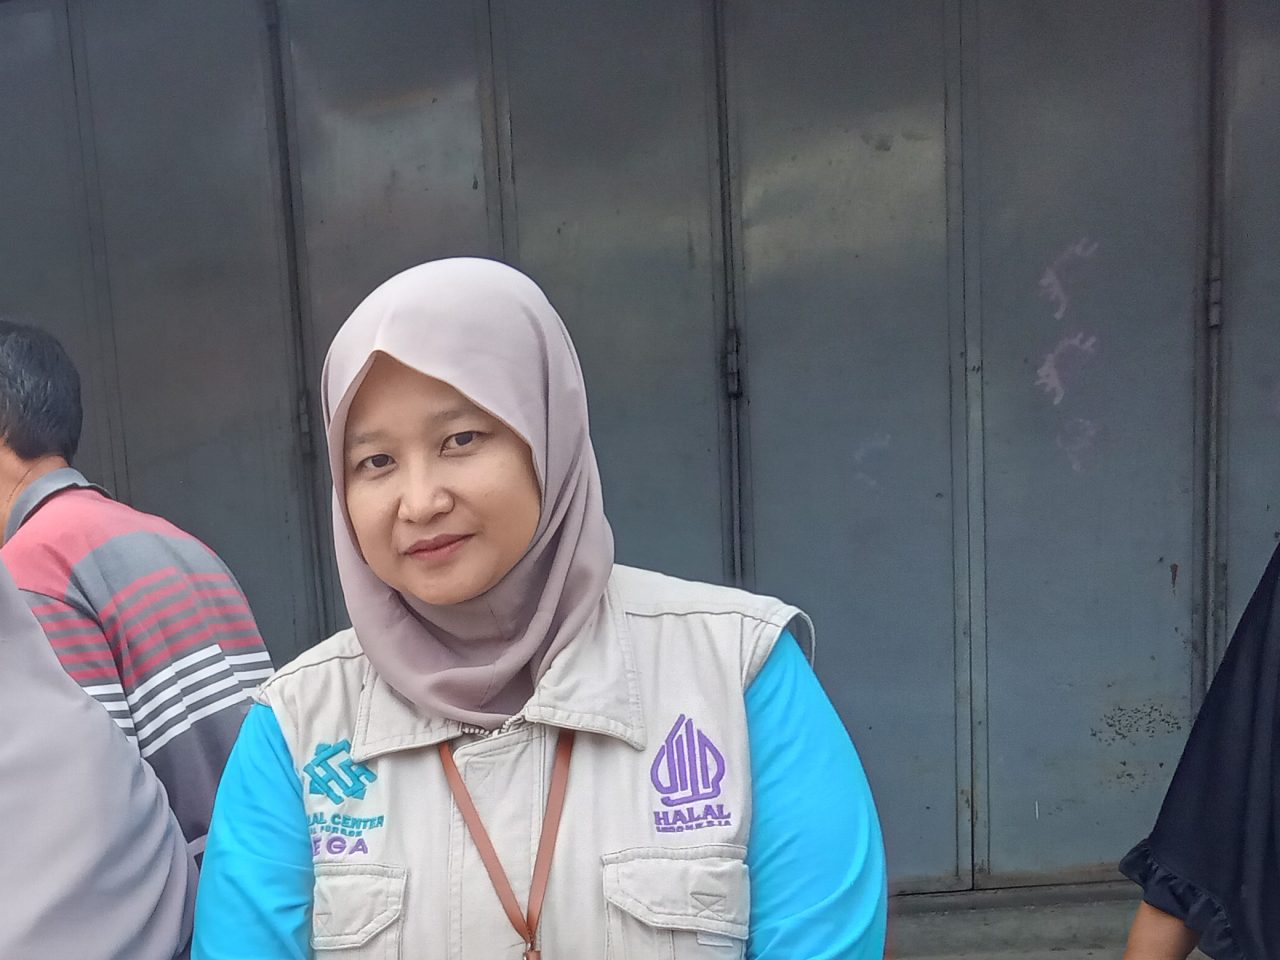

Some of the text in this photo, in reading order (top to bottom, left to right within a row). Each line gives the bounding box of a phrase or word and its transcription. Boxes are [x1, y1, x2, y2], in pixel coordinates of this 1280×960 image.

[330, 813, 385, 830] CENTER
[653, 804, 732, 826] HALAL
[655, 820, 732, 833] INDONESIA
[311, 836, 369, 856] EGA
